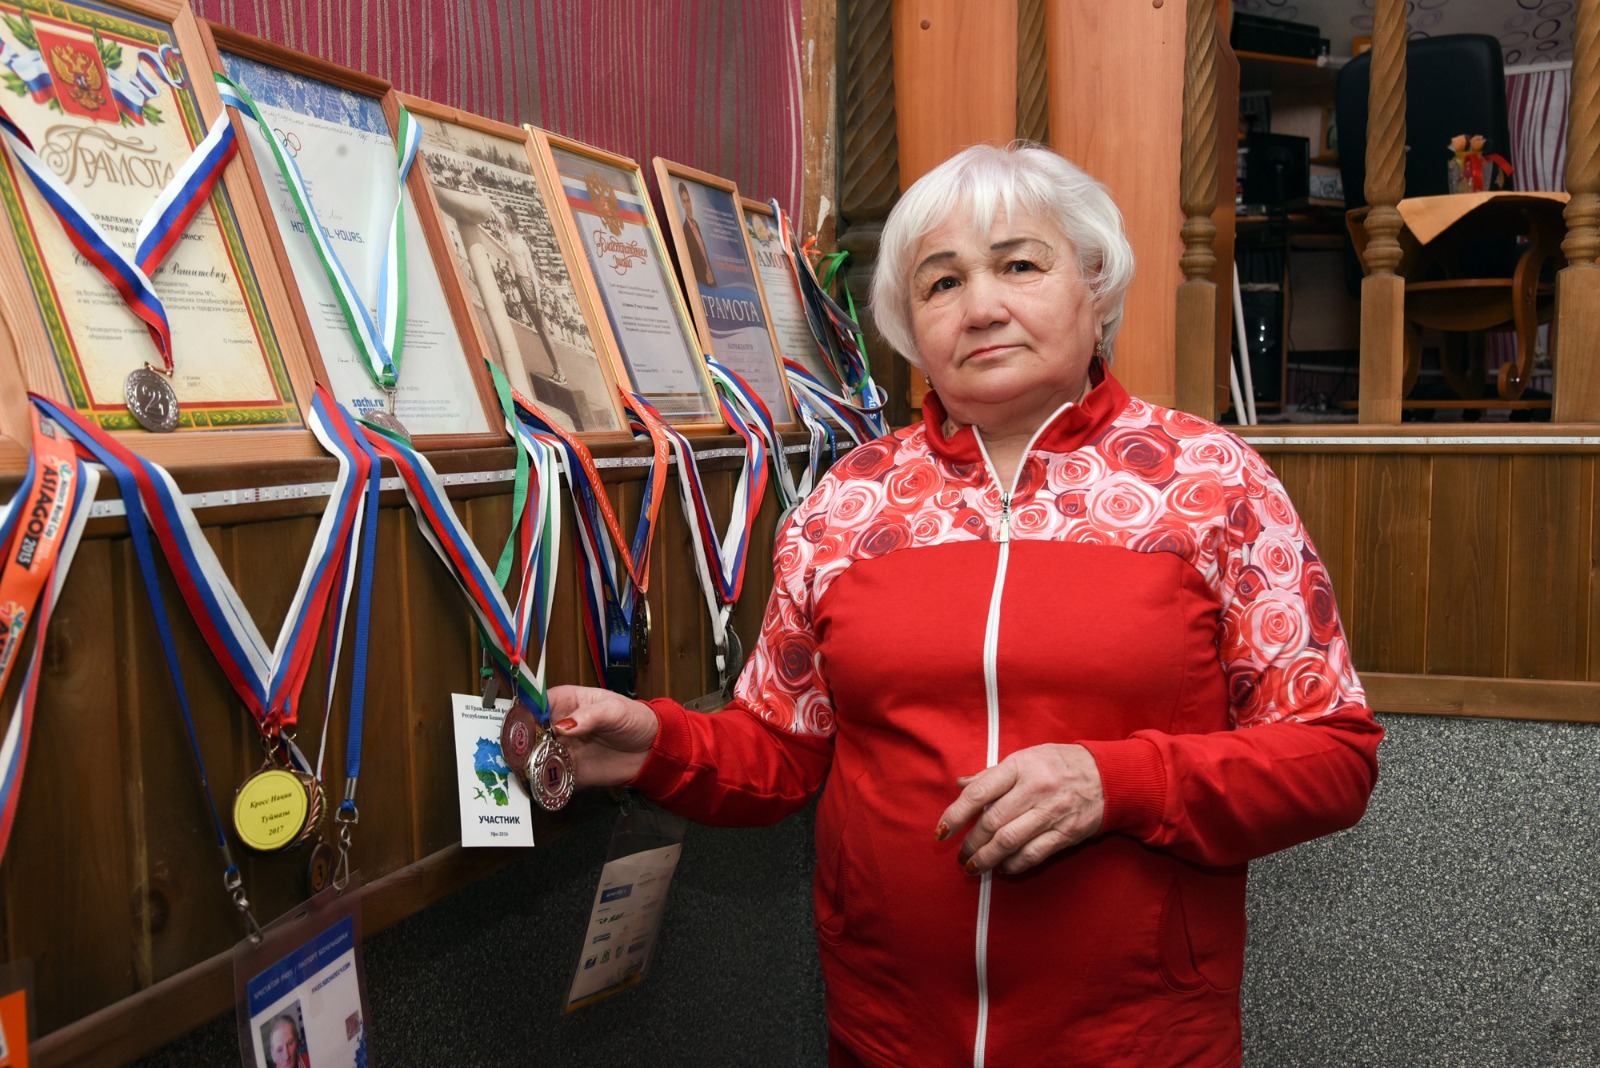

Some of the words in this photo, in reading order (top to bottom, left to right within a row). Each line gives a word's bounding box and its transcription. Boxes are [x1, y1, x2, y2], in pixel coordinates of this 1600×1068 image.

[40, 125, 176, 190] ГРАМОТА
[91, 213, 134, 226] ПРАВЛЕНИЕ
[700, 294, 760, 323] ГРАМОТА
[351, 396, 385, 408] sochi.ru
[659, 440, 668, 464] UFA
[28, 463, 59, 536] ASIAGO
[18, 537, 38, 565] 2015
[517, 730, 524, 746] 2
[249, 798, 270, 809] Кросс
[260, 809, 291, 825] Туймазы
[478, 815, 521, 825] УЧАСТНИК
[268, 825, 285, 837] 2017
